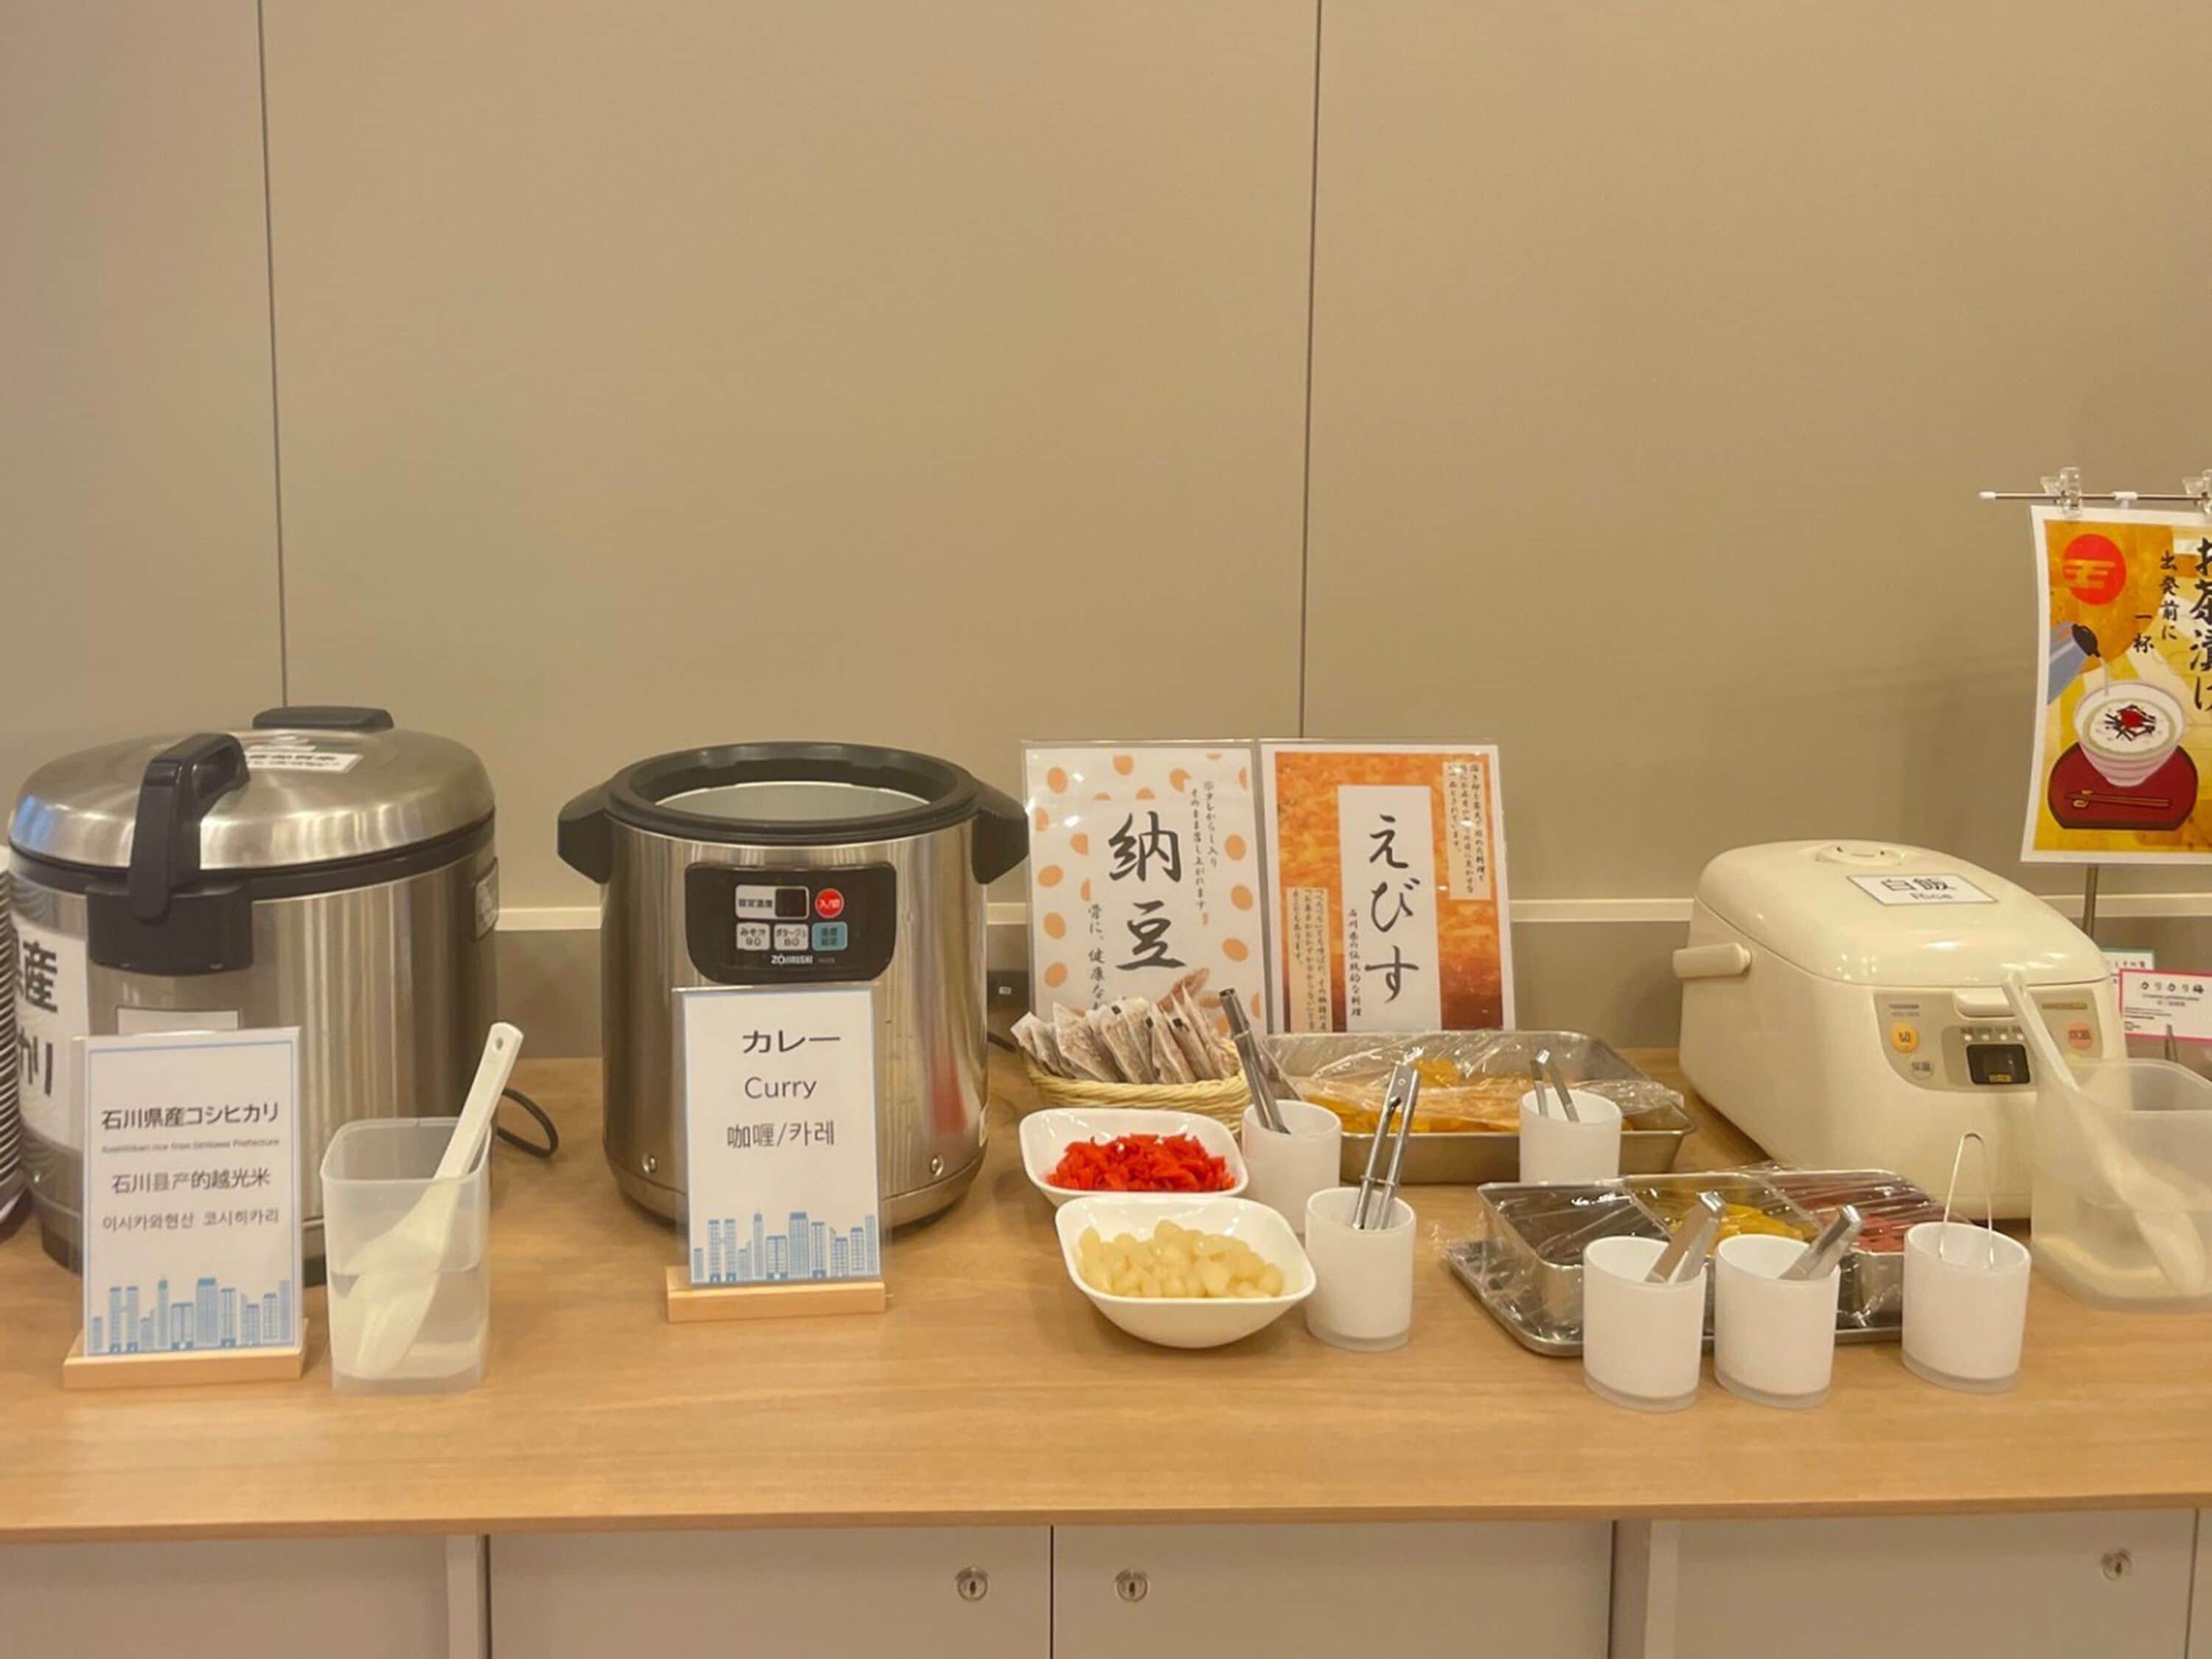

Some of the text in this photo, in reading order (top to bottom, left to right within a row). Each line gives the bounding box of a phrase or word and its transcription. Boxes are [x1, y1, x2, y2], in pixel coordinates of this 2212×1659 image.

[2160, 550, 2179, 640] 出発前に
[2133, 614, 2154, 653] 一杯
[1108, 810, 1188, 970] 納豆
[1364, 813, 1421, 1004] えびす
[742, 1030, 841, 1053] カレー
[744, 1077, 817, 1099] Curry
[101, 1102, 279, 1130] 石川県産コシヒカリ
[112, 1167, 271, 1195] 石川县产的越光米
